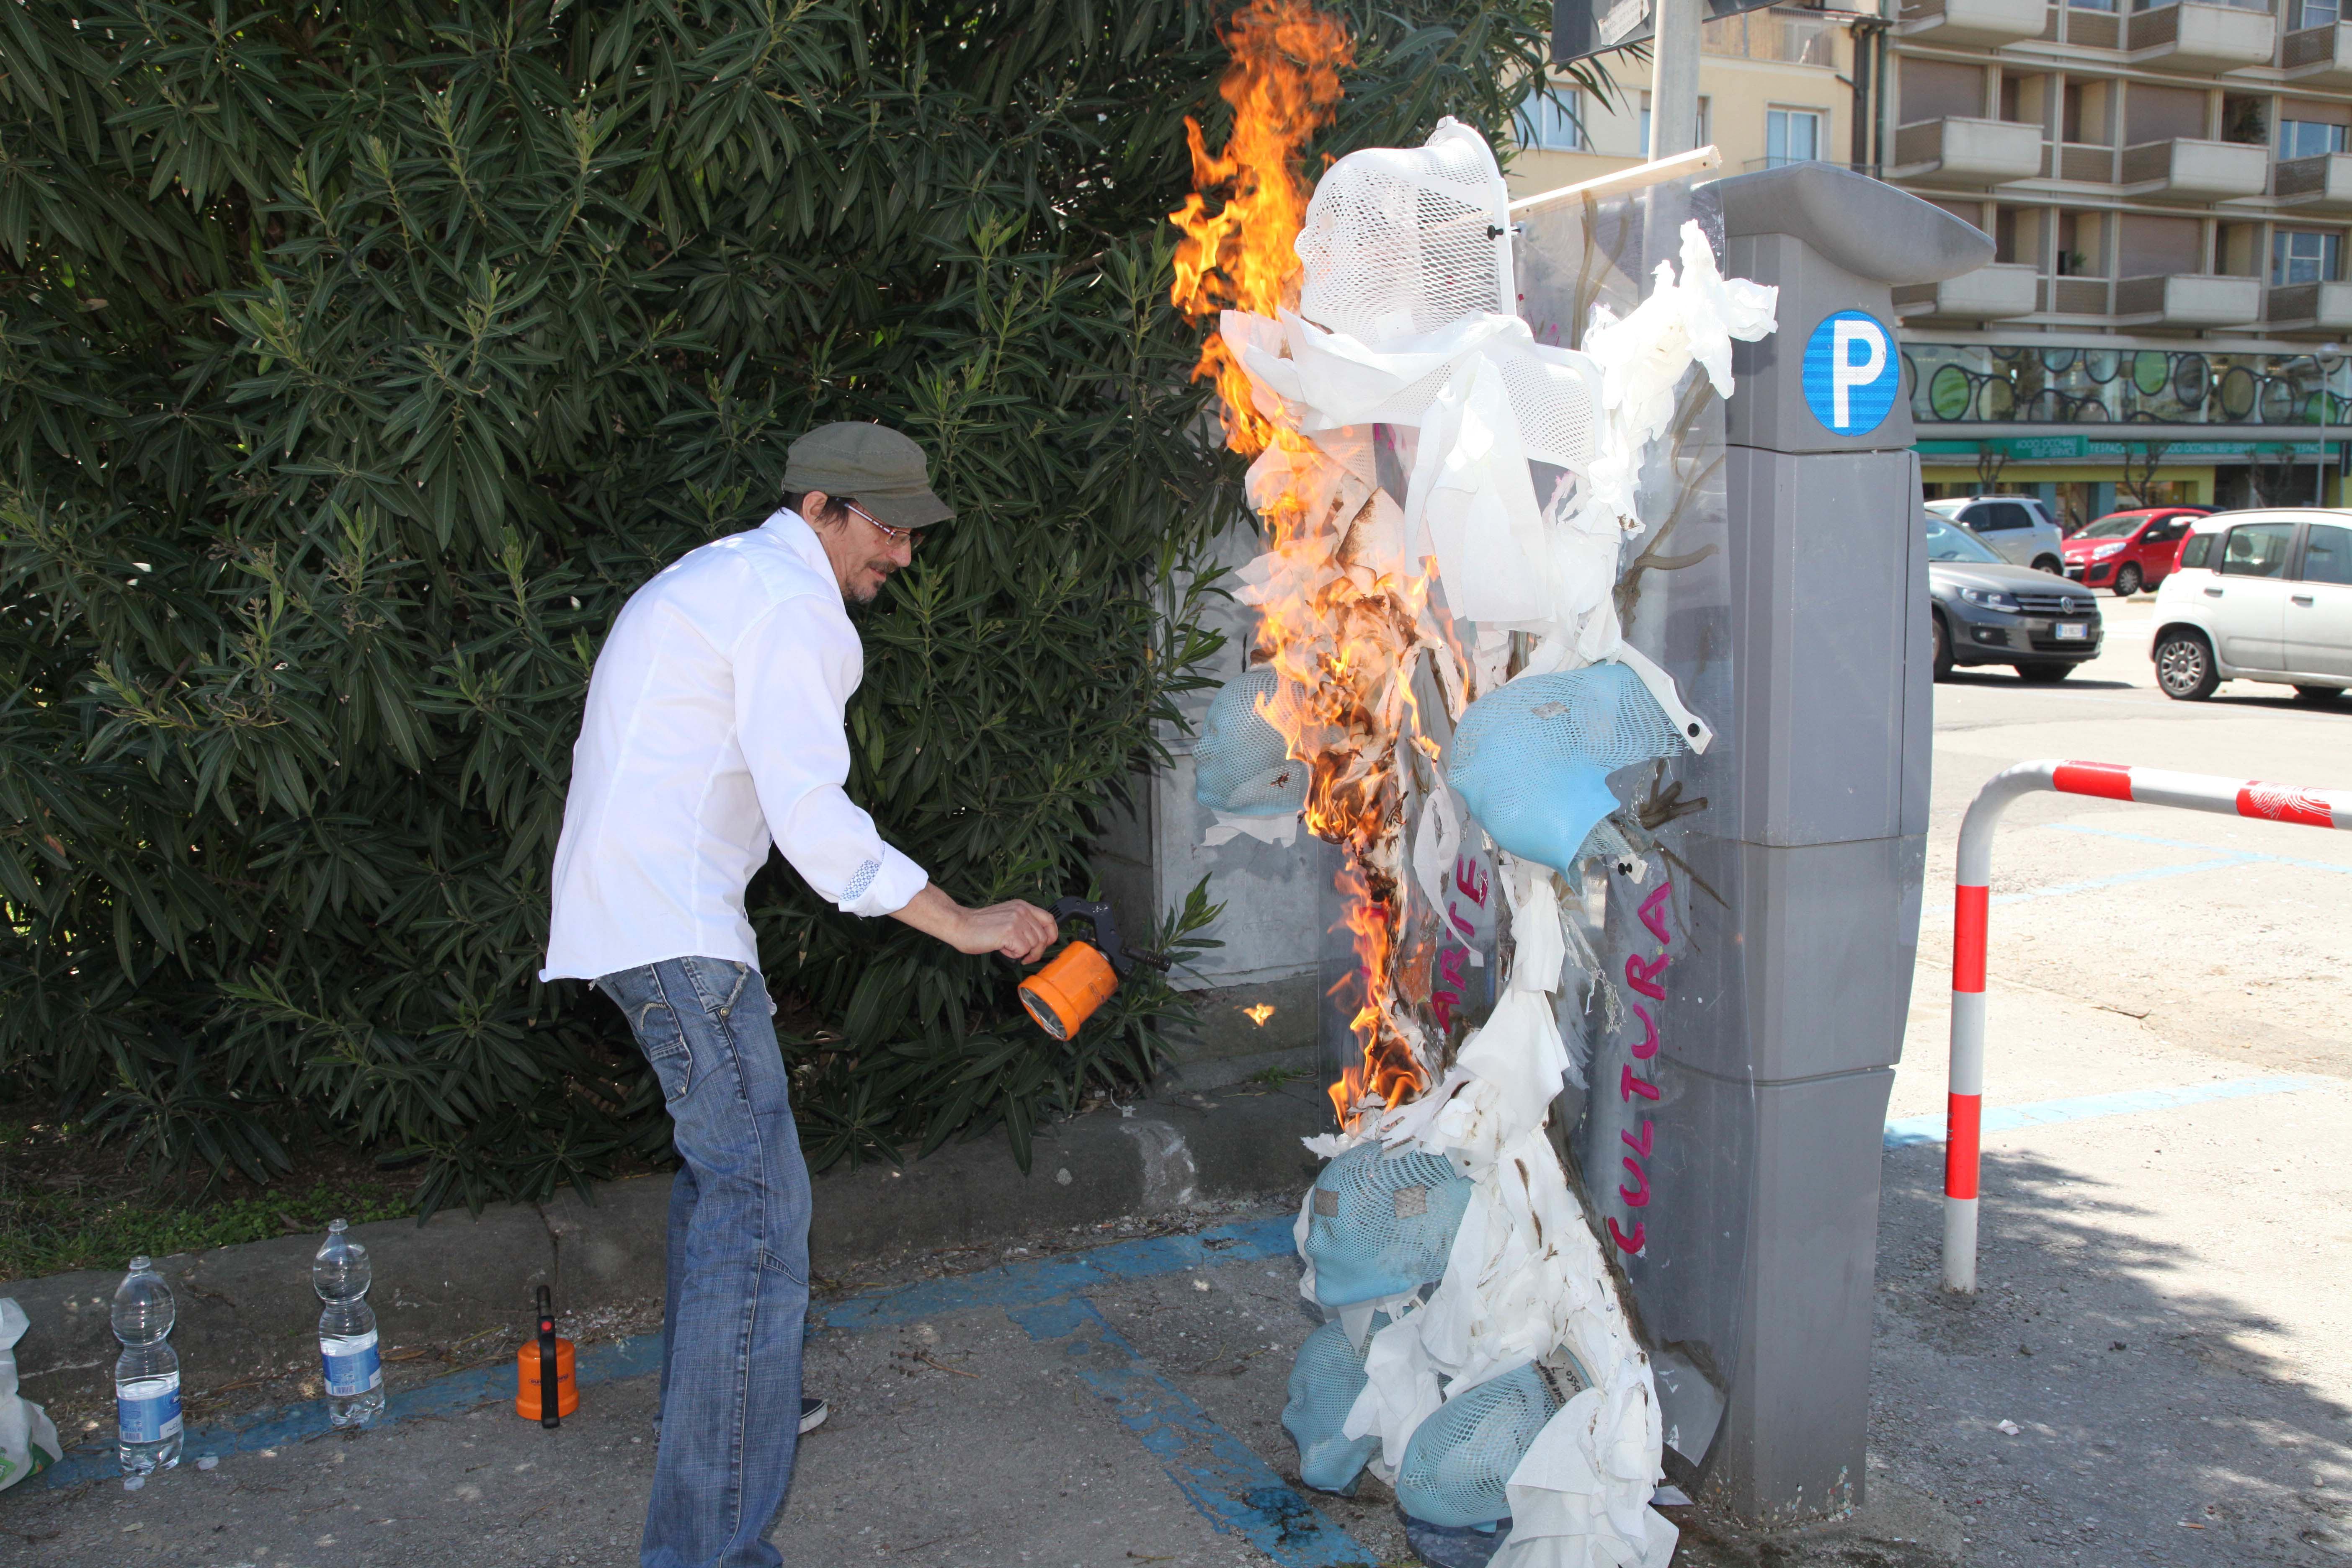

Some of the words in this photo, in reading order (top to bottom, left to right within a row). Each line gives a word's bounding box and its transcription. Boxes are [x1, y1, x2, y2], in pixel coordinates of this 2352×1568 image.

[1833, 320, 1887, 428] P
[1431, 854, 1488, 1034] ARTE
[1607, 882, 1673, 1255] CULTURA
